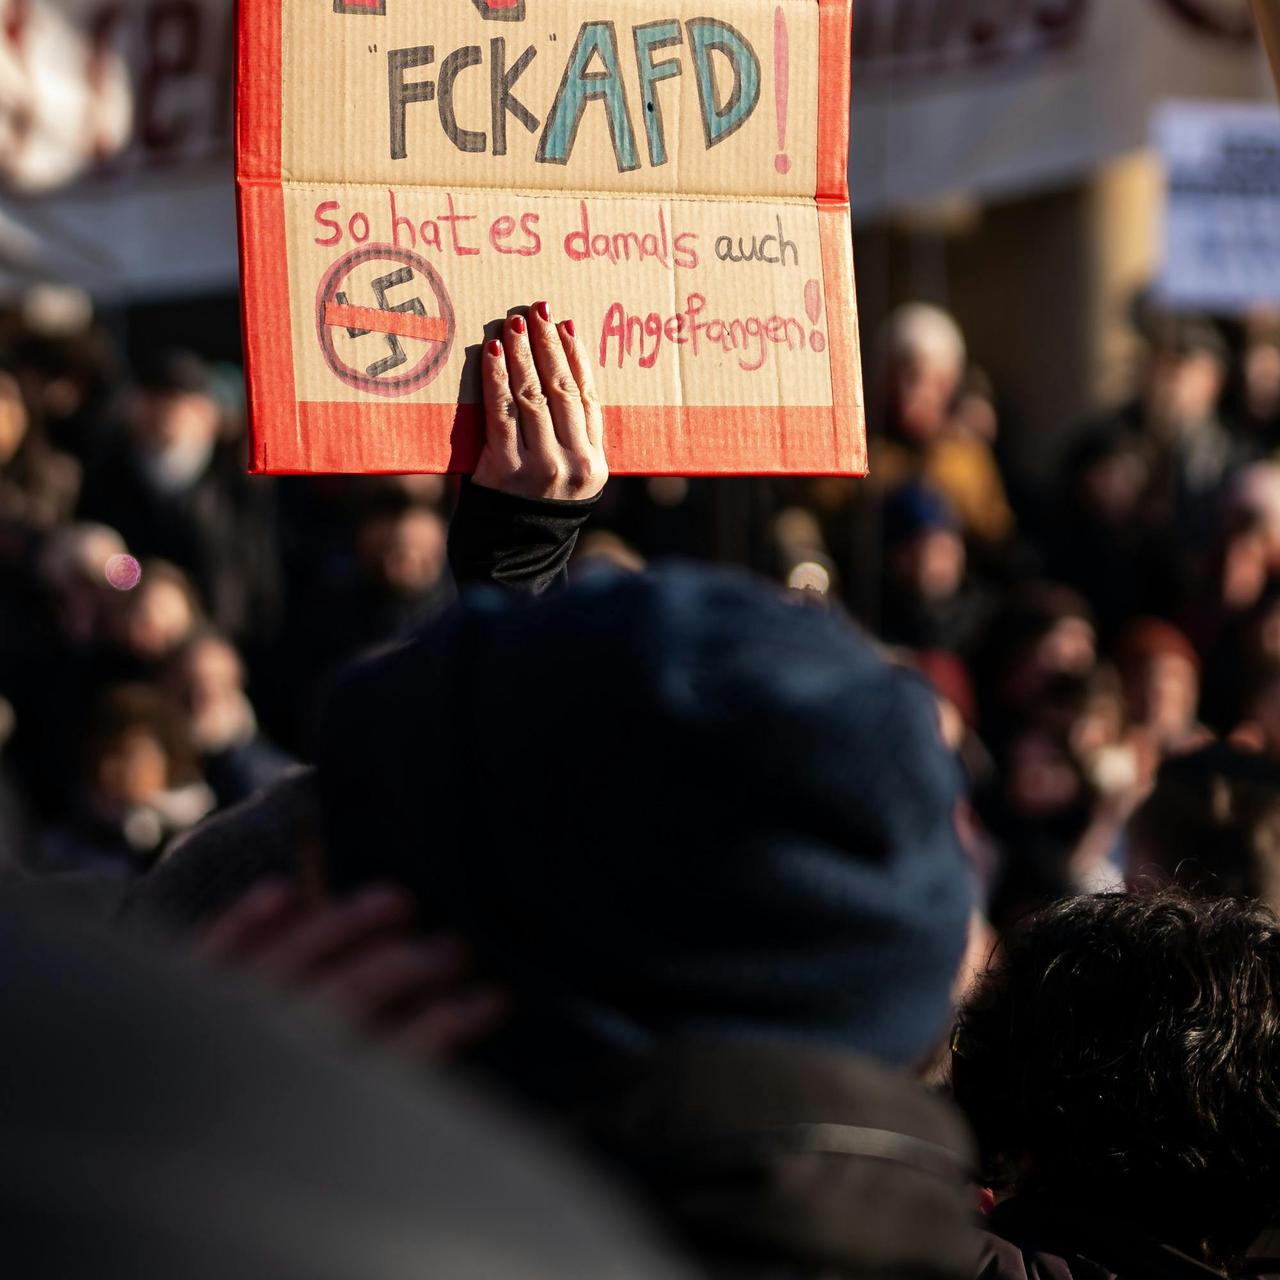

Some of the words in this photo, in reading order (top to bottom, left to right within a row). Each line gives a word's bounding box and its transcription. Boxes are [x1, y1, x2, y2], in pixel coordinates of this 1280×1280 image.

[388, 189, 480, 256] hat
[488, 211, 543, 257] es
[563, 199, 701, 270] damals
[714, 214, 800, 267] auch
[598, 278, 826, 372] Angefangen!
